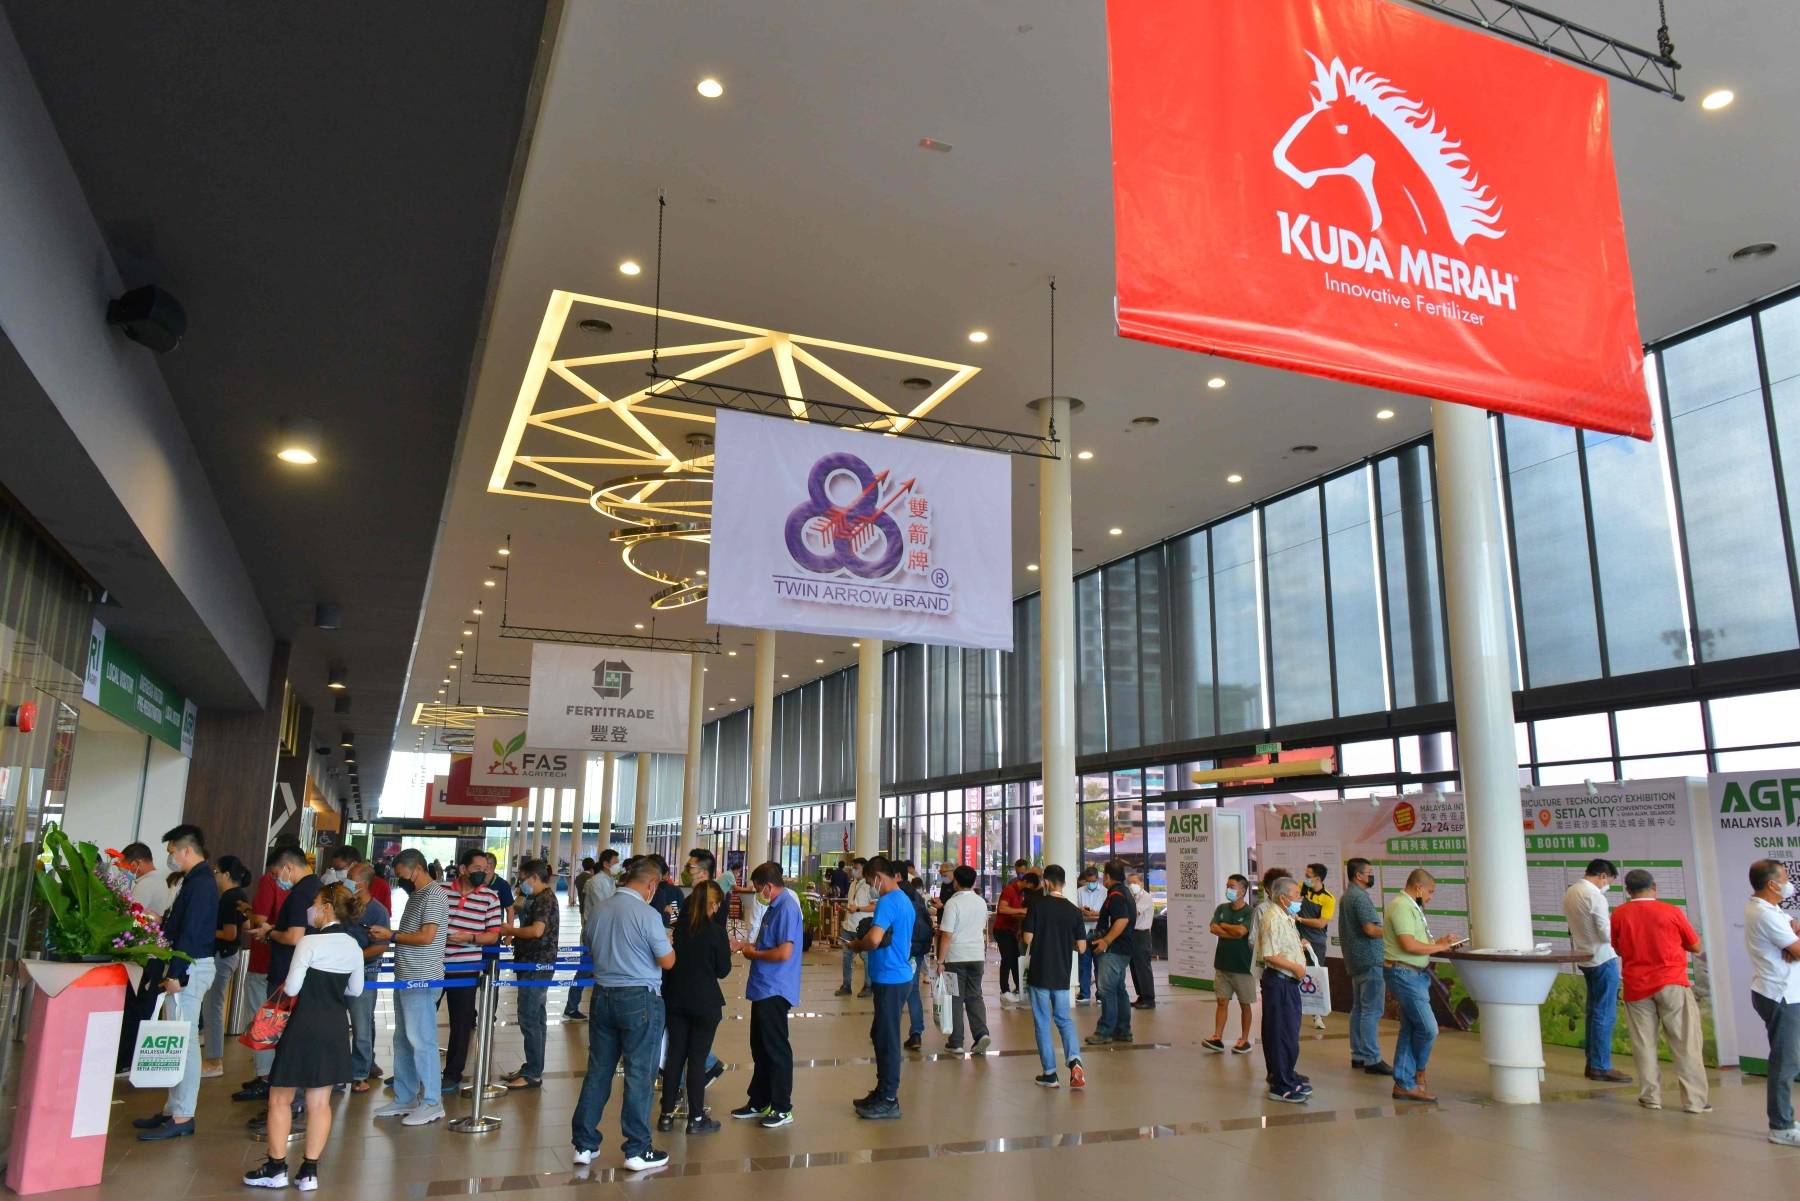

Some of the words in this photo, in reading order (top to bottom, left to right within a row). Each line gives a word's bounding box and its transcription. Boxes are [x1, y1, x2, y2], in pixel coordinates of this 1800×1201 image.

[1276, 210, 1393, 279] KUDA
[1400, 244, 1517, 310] MERAH
[1325, 272, 1411, 309] Innovative
[1416, 294, 1485, 326] Fertilizer
[907, 497, 929, 572] 雙箭牌
[774, 580, 818, 598] TWIN
[823, 585, 889, 606] ARROW
[893, 593, 949, 611] BRAND
[566, 705, 655, 720] FERTITRADE
[522, 753, 568, 771] FAS
[522, 770, 567, 778] AGRITECH
[1420, 803, 1453, 812] MALAYSIA
[1565, 794, 1623, 806] TECHNOLOGY
[1625, 791, 1676, 803] EXHIBITION
[1616, 804, 1652, 812] CONVENTION
[1555, 807, 1586, 819] SETIA
[1588, 806, 1615, 818] CITY
[1168, 813, 1209, 841] AGRI
[1280, 812, 1317, 836] AGRI
[1720, 816, 1782, 829] MALAYSIA
[1537, 837, 1575, 849] BOOTH
[1580, 836, 1601, 849] NO.
[1754, 836, 1784, 848] SCAN
[536, 963, 554, 971] Setia
[406, 980, 429, 989] Setia
[141, 1035, 185, 1053] AGRI
